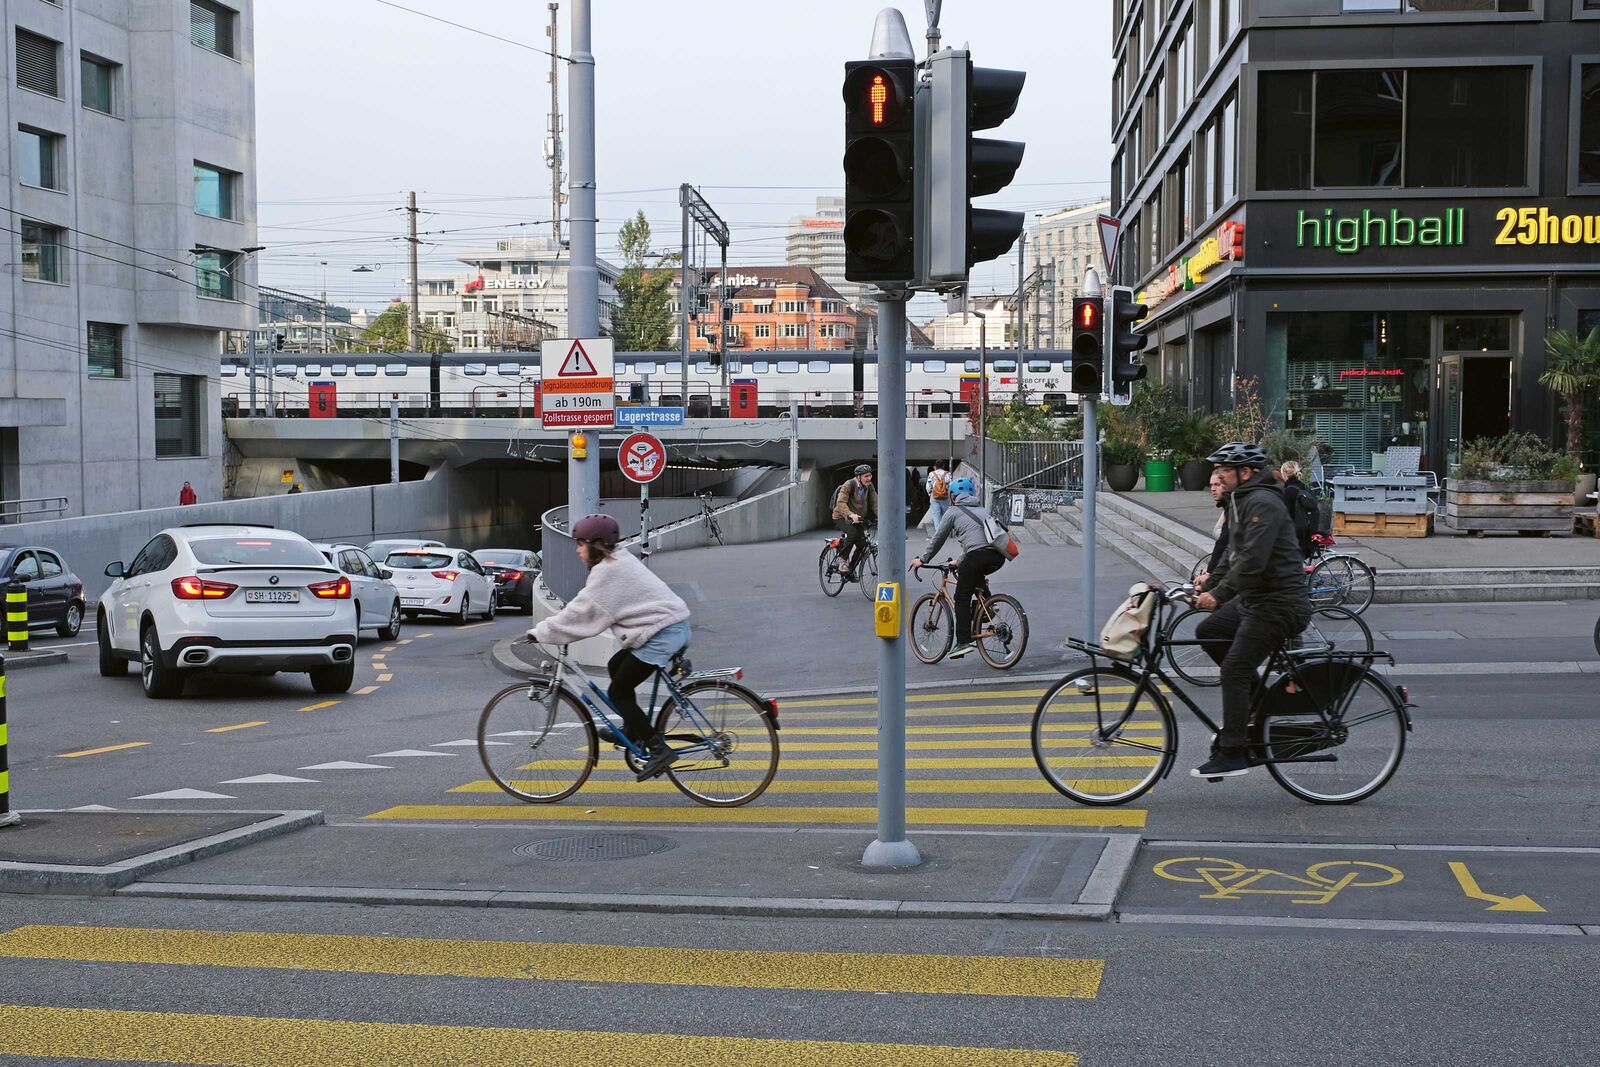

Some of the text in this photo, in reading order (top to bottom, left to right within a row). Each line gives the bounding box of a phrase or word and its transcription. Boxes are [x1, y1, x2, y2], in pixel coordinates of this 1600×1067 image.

[1297, 207, 1465, 253] highball
[1495, 207, 1600, 245] 25hou
[484, 278, 548, 289] ENERGY
[543, 380, 613, 392] Signalisationsänderung
[555, 396, 602, 408] ab 190m
[544, 412, 613, 424] Zollstrasse gesperrt
[619, 410, 681, 424] Lagerstrasse
